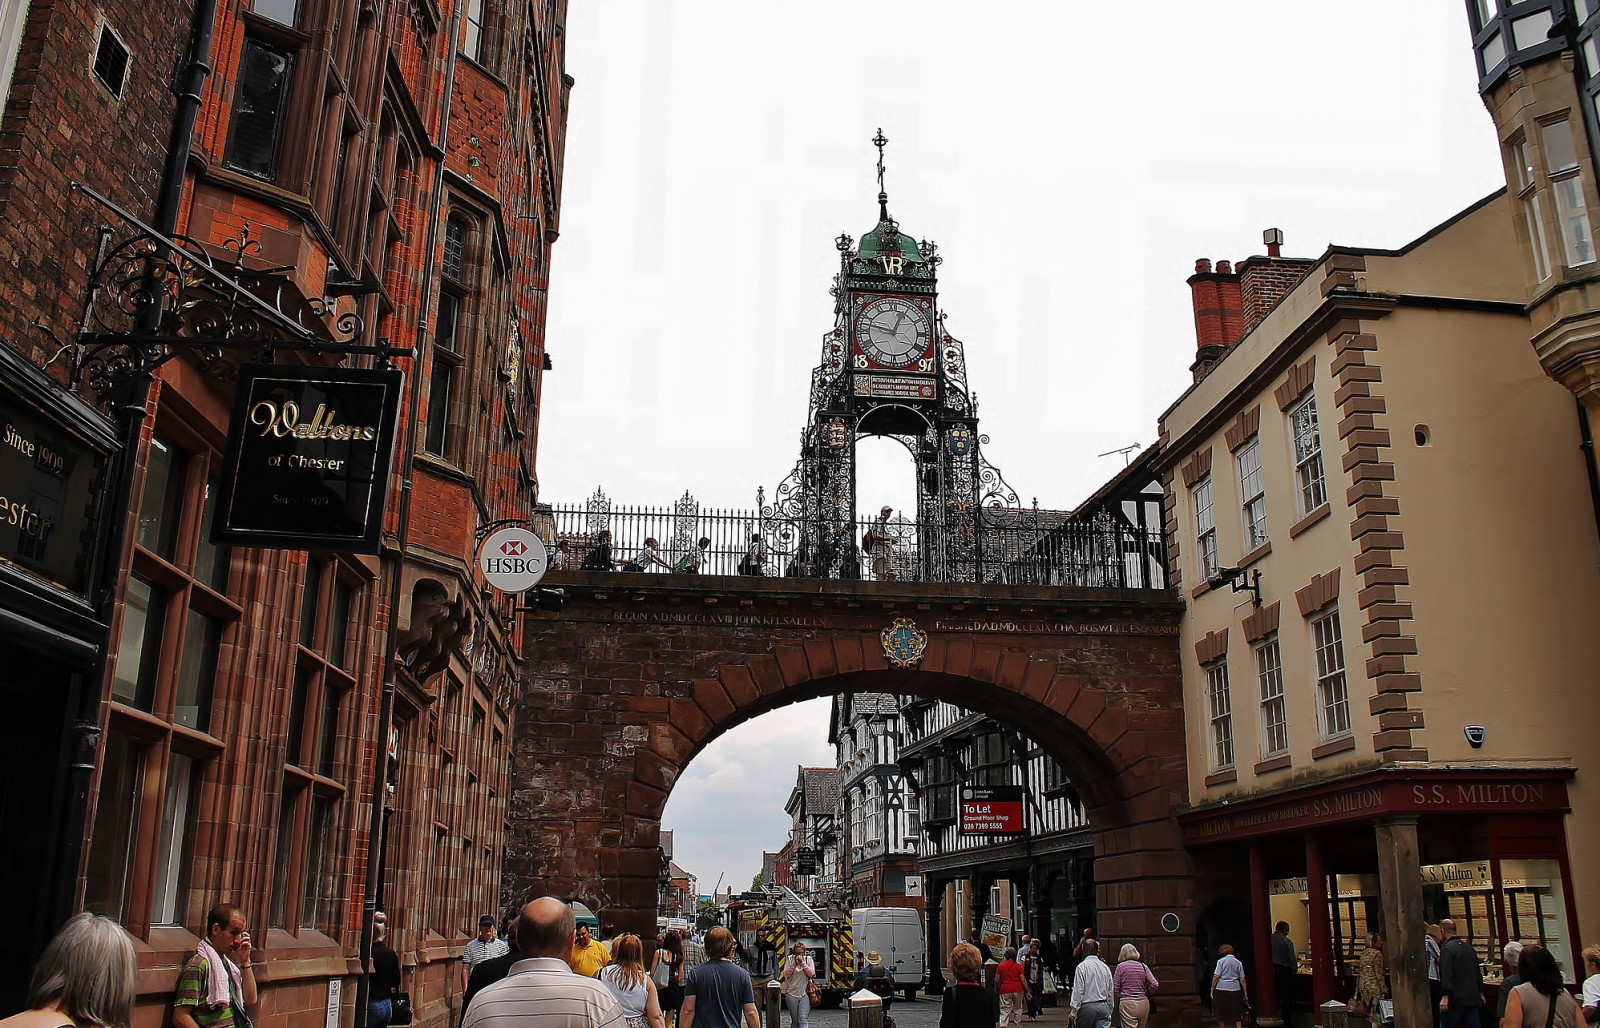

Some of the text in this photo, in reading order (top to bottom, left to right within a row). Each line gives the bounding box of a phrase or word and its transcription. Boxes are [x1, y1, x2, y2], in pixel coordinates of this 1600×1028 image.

[853, 354, 933, 372] 18 97
[250, 399, 376, 441] Waltons
[3, 423, 64, 474] Since 1909
[268, 453, 345, 470] of Chester
[485, 558, 540, 574] HSBC
[613, 611, 648, 621] BEGUN
[735, 613, 760, 626] JOHN
[1413, 784, 1544, 804] S.S. MILTON
[963, 804, 991, 814] To Let
[1313, 798, 1334, 818] S.S.
[1335, 788, 1383, 813] MILTON
[1440, 865, 1473, 882] Milton
